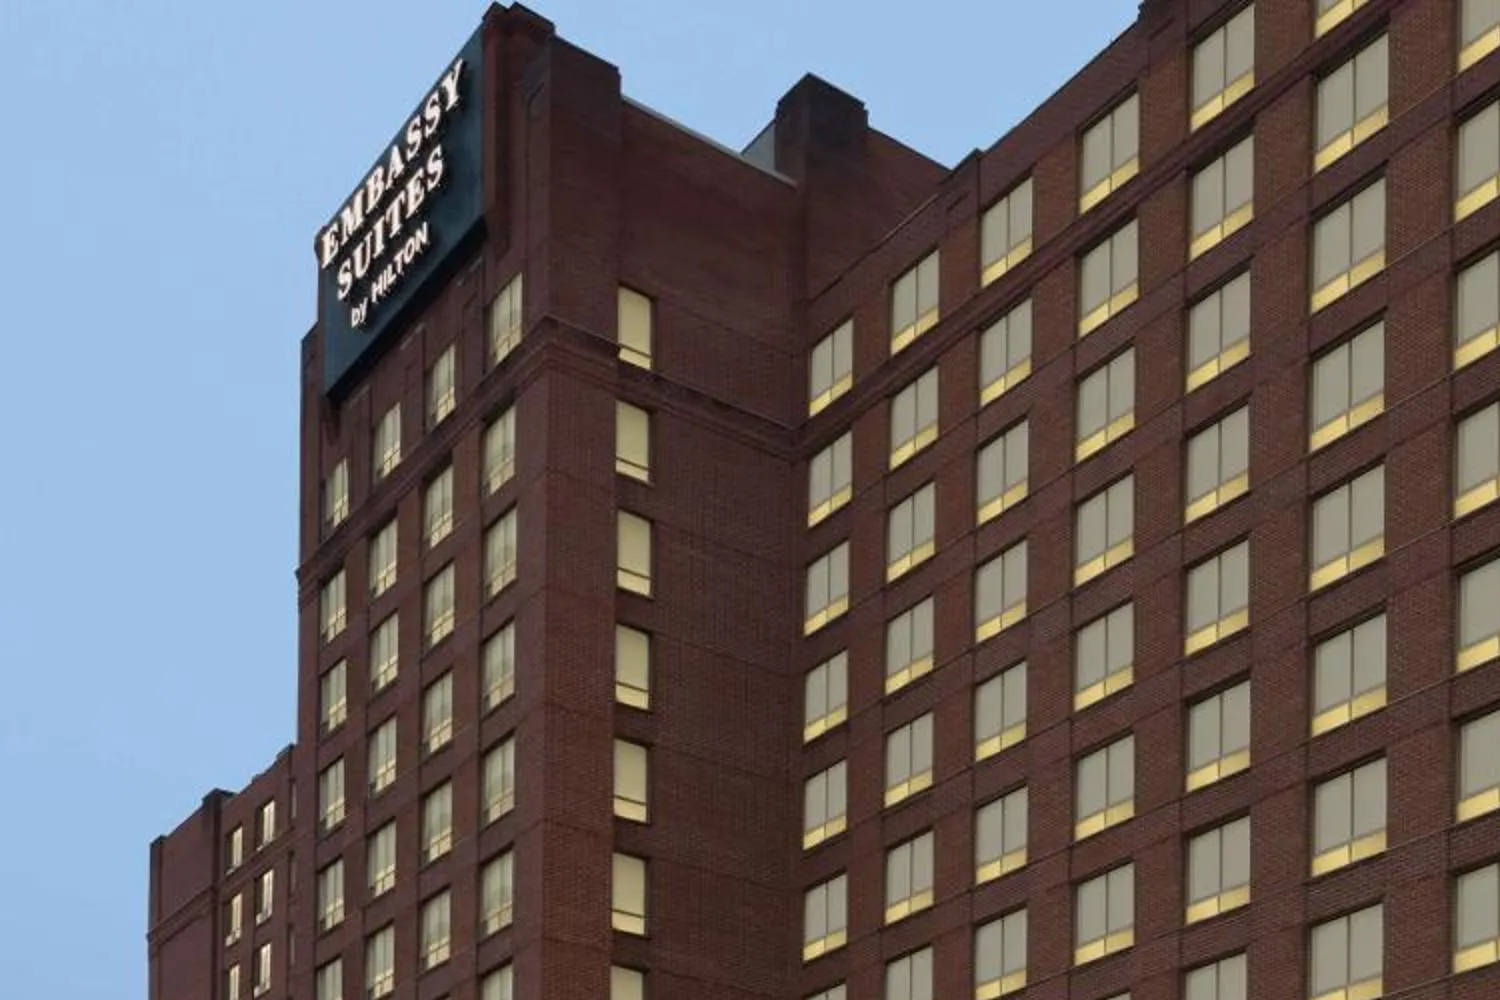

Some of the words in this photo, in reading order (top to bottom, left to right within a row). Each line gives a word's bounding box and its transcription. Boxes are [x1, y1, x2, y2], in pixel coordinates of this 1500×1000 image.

[321, 59, 463, 268] EMBASSY
[337, 145, 443, 300] SUITES
[371, 222, 428, 303] HILTON
